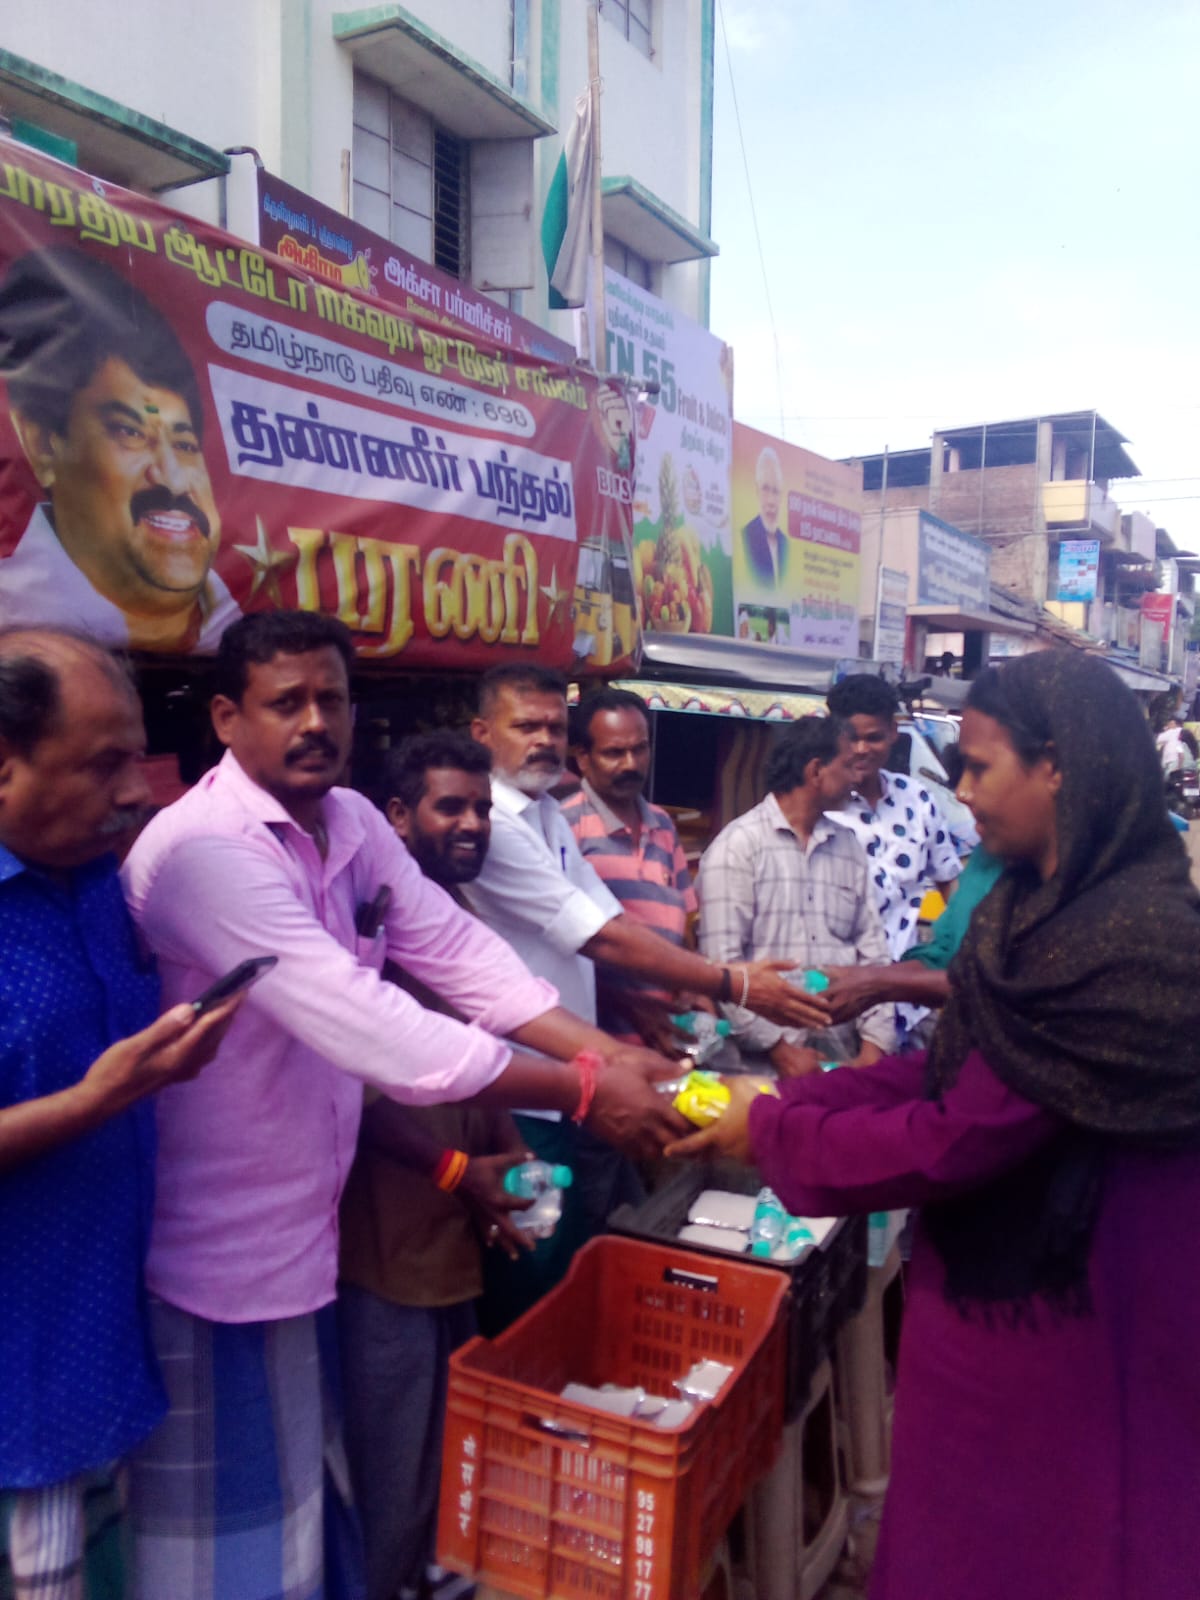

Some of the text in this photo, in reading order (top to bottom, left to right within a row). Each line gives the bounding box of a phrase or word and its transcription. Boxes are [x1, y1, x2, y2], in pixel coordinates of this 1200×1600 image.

[163, 227, 307, 313] ஆட்டோ
[230, 320, 357, 383] தமிழ்நாடு
[361, 364, 416, 405] பதிவு
[420, 383, 467, 415] எண்
[642, 349, 677, 414] 55
[231, 400, 463, 492] தண்ணீர்
[468, 449, 572, 523] பந்தல்
[287, 526, 540, 657] பரணி
[636, 1513, 654, 1533] 27
[634, 1580, 652, 1600] 77
[635, 1559, 652, 1580] 17
